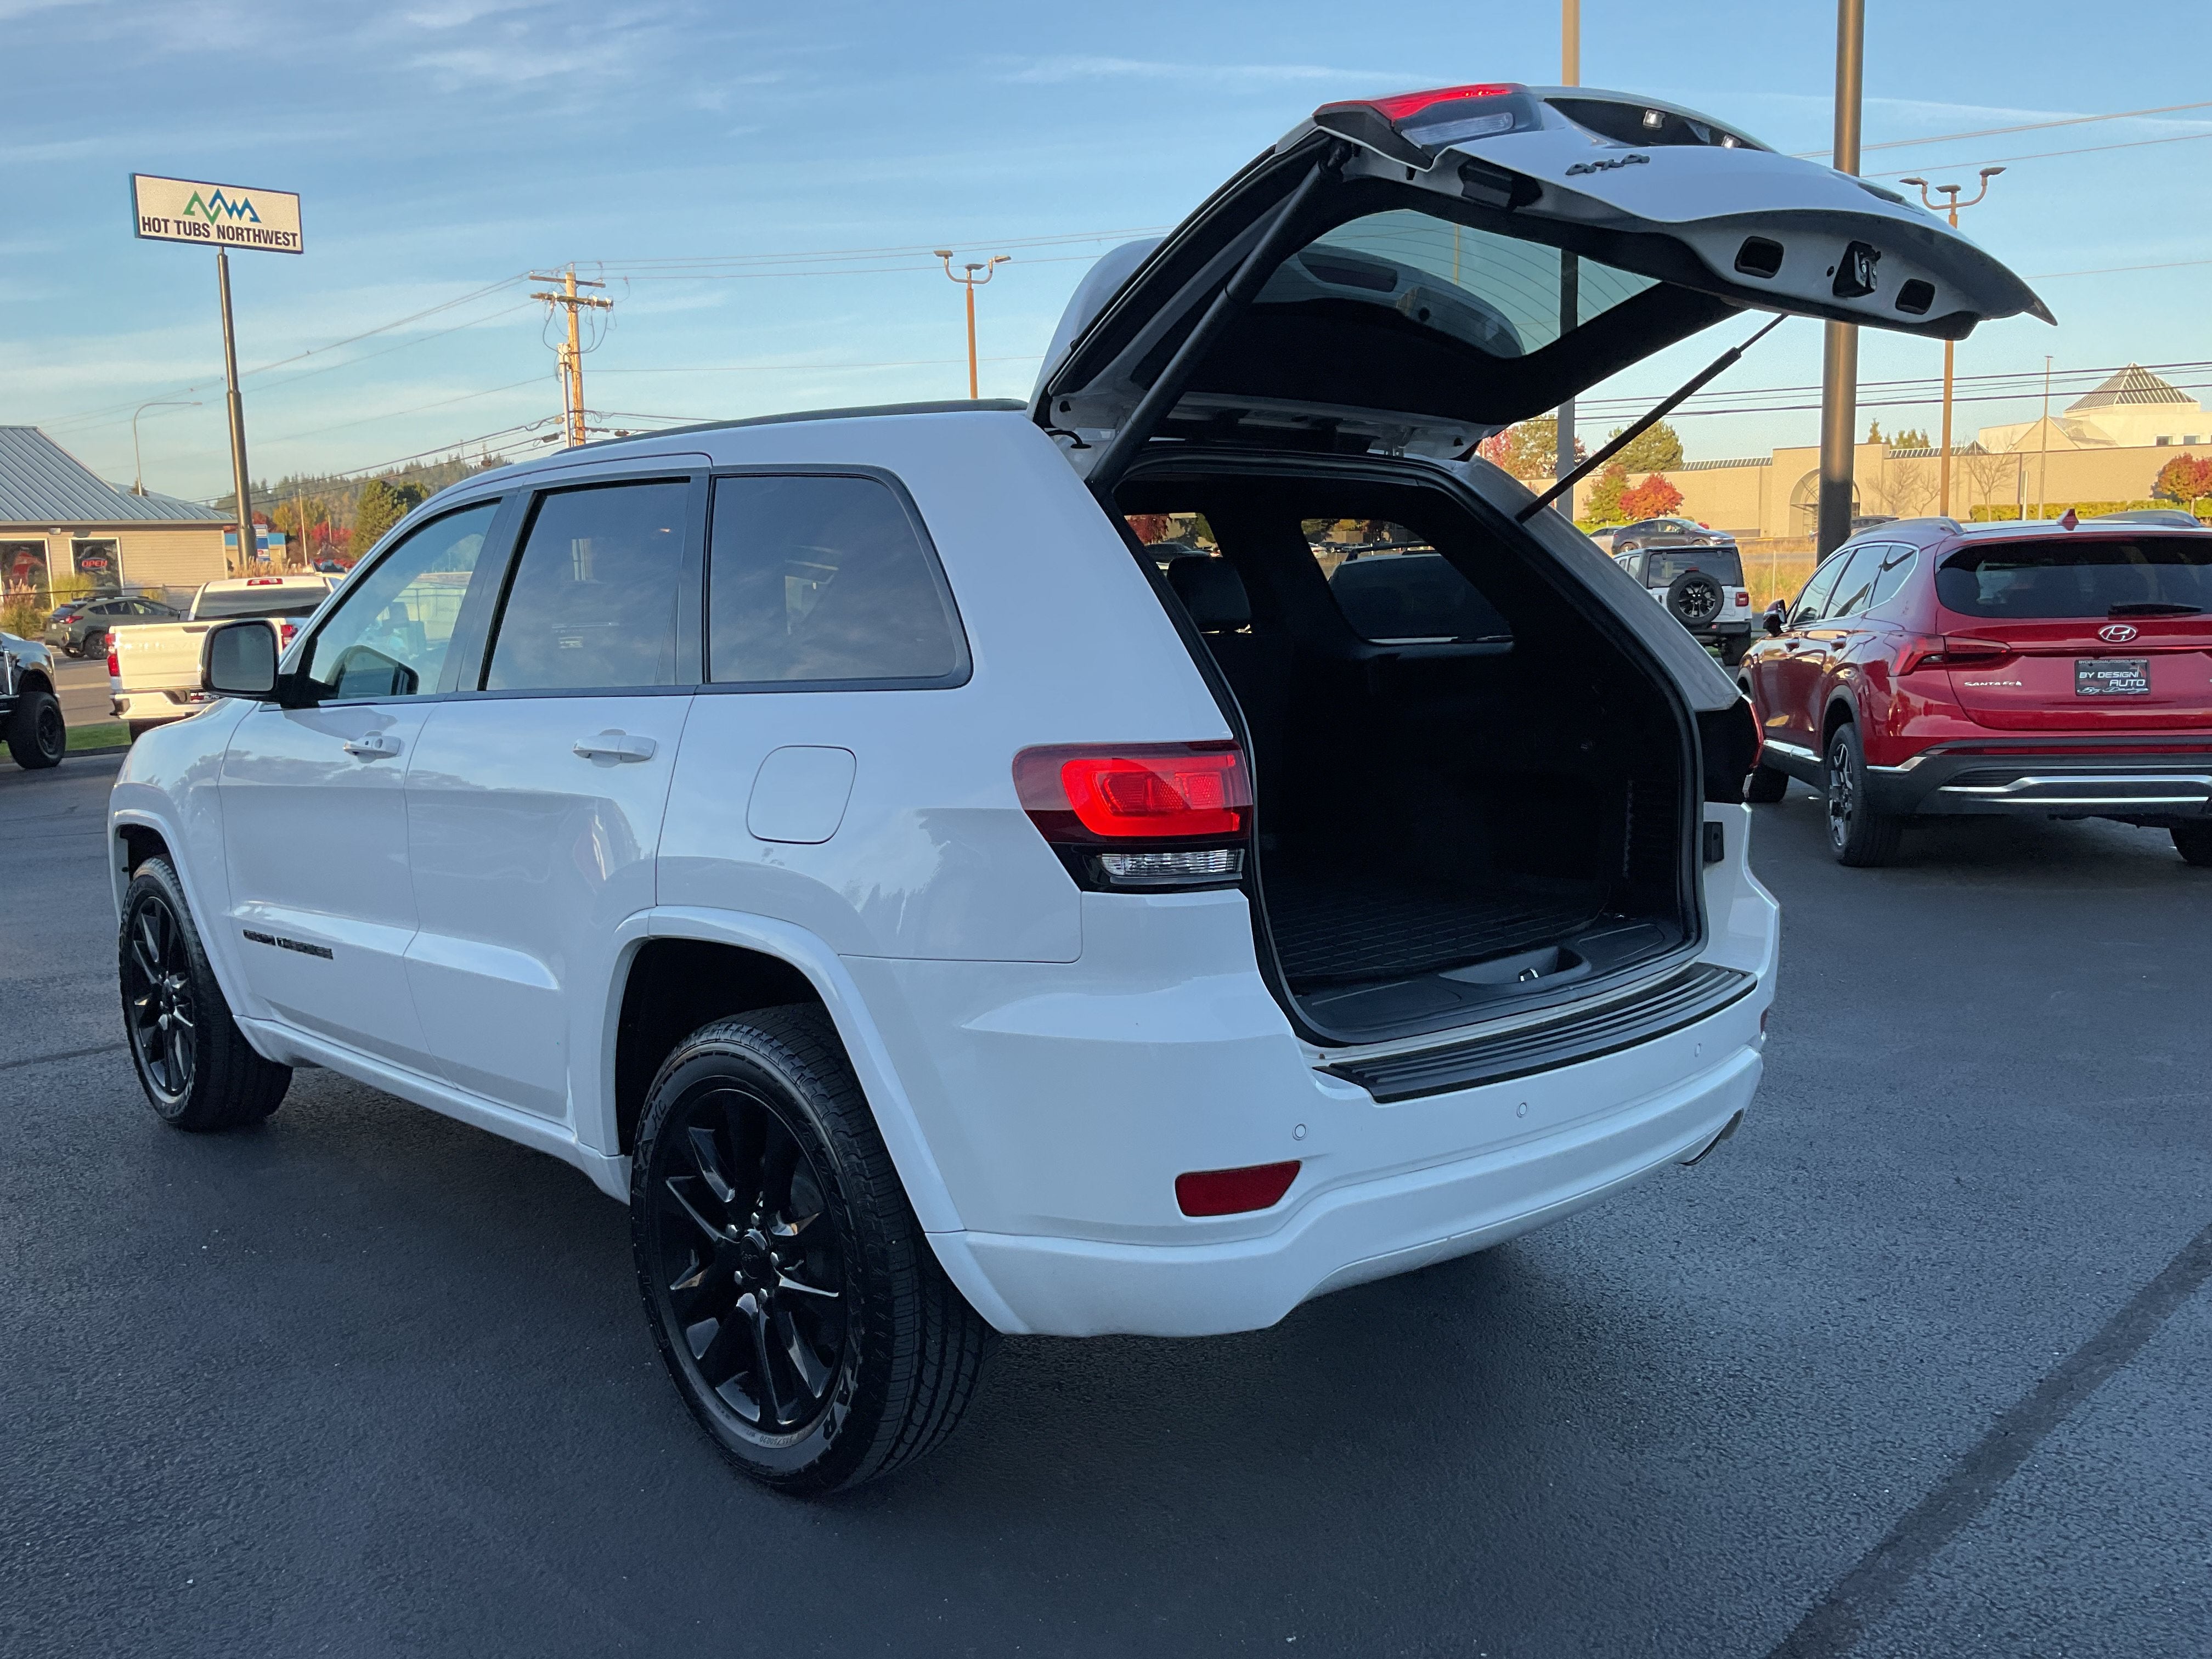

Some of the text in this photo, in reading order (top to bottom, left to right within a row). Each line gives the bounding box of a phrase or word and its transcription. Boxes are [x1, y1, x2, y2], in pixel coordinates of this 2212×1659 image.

[142, 216, 298, 246] HOT TUBS NORTHWEST
